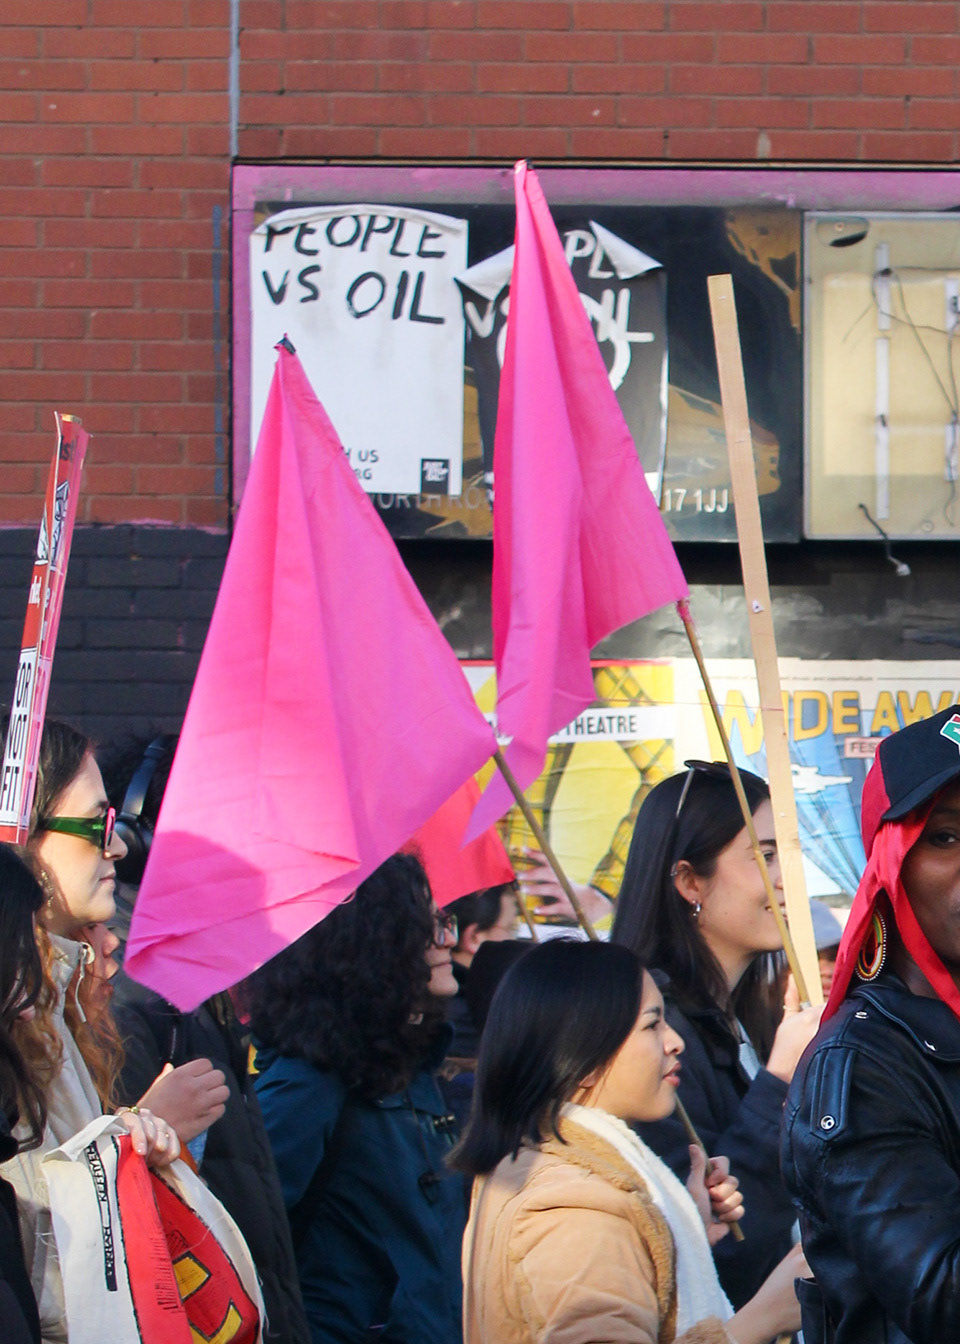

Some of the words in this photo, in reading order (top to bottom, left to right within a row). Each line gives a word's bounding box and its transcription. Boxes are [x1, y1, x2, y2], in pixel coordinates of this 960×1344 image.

[264, 214, 446, 258] PEOPLE
[262, 264, 322, 305] VS
[346, 270, 445, 324] OIL
[693, 489, 729, 513] 1JJ
[565, 715, 637, 736] THEATRE
[850, 741, 878, 755] FES
